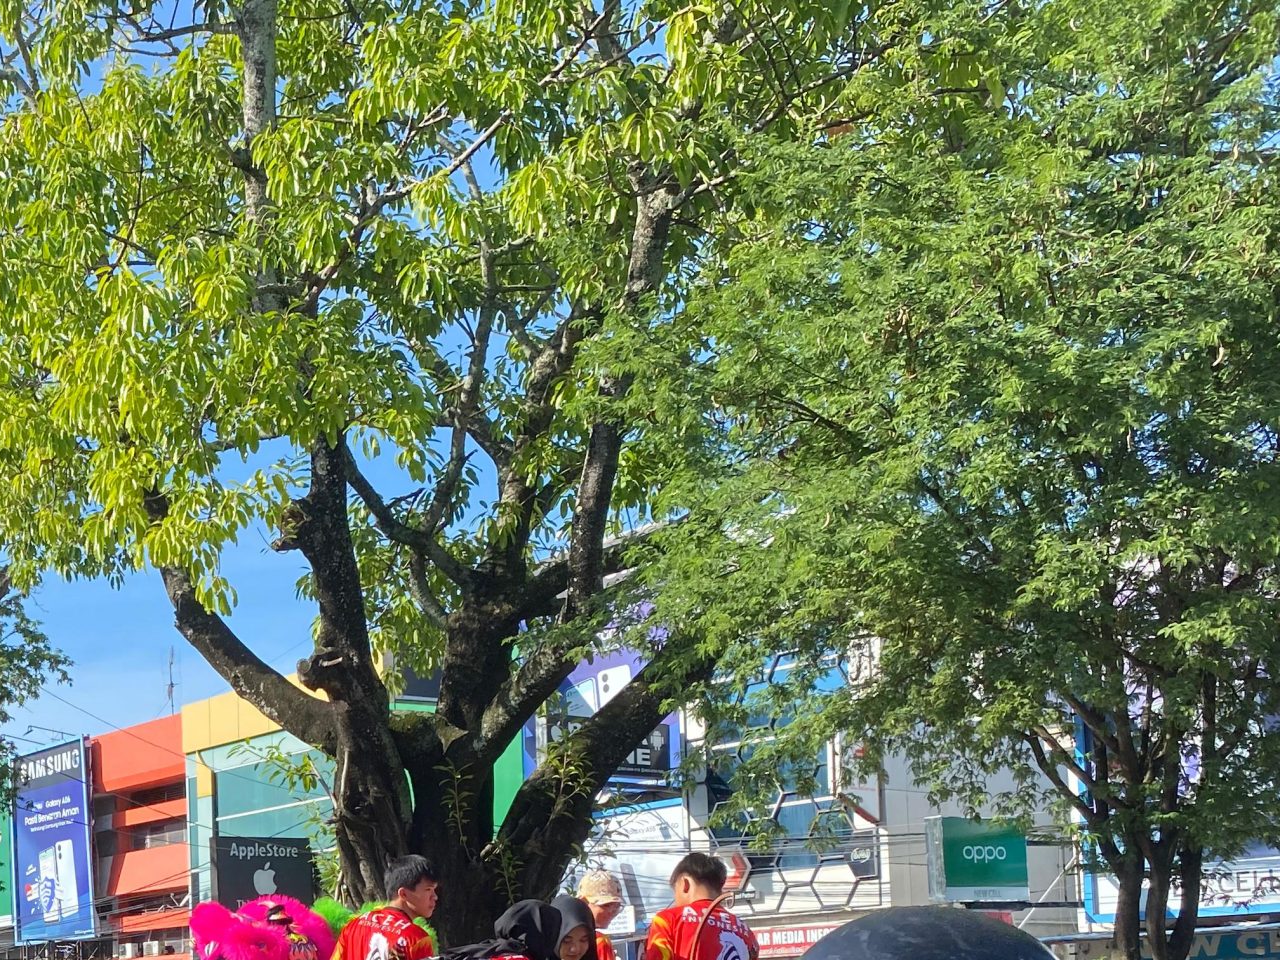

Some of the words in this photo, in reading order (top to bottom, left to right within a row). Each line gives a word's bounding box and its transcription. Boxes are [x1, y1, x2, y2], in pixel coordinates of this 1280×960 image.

[20, 749, 80, 782] SAMSUNG
[230, 842, 298, 860] AppleStore
[963, 846, 1006, 863] oppo
[359, 911, 412, 929] ACEH
[772, 929, 803, 945] MEDIA
